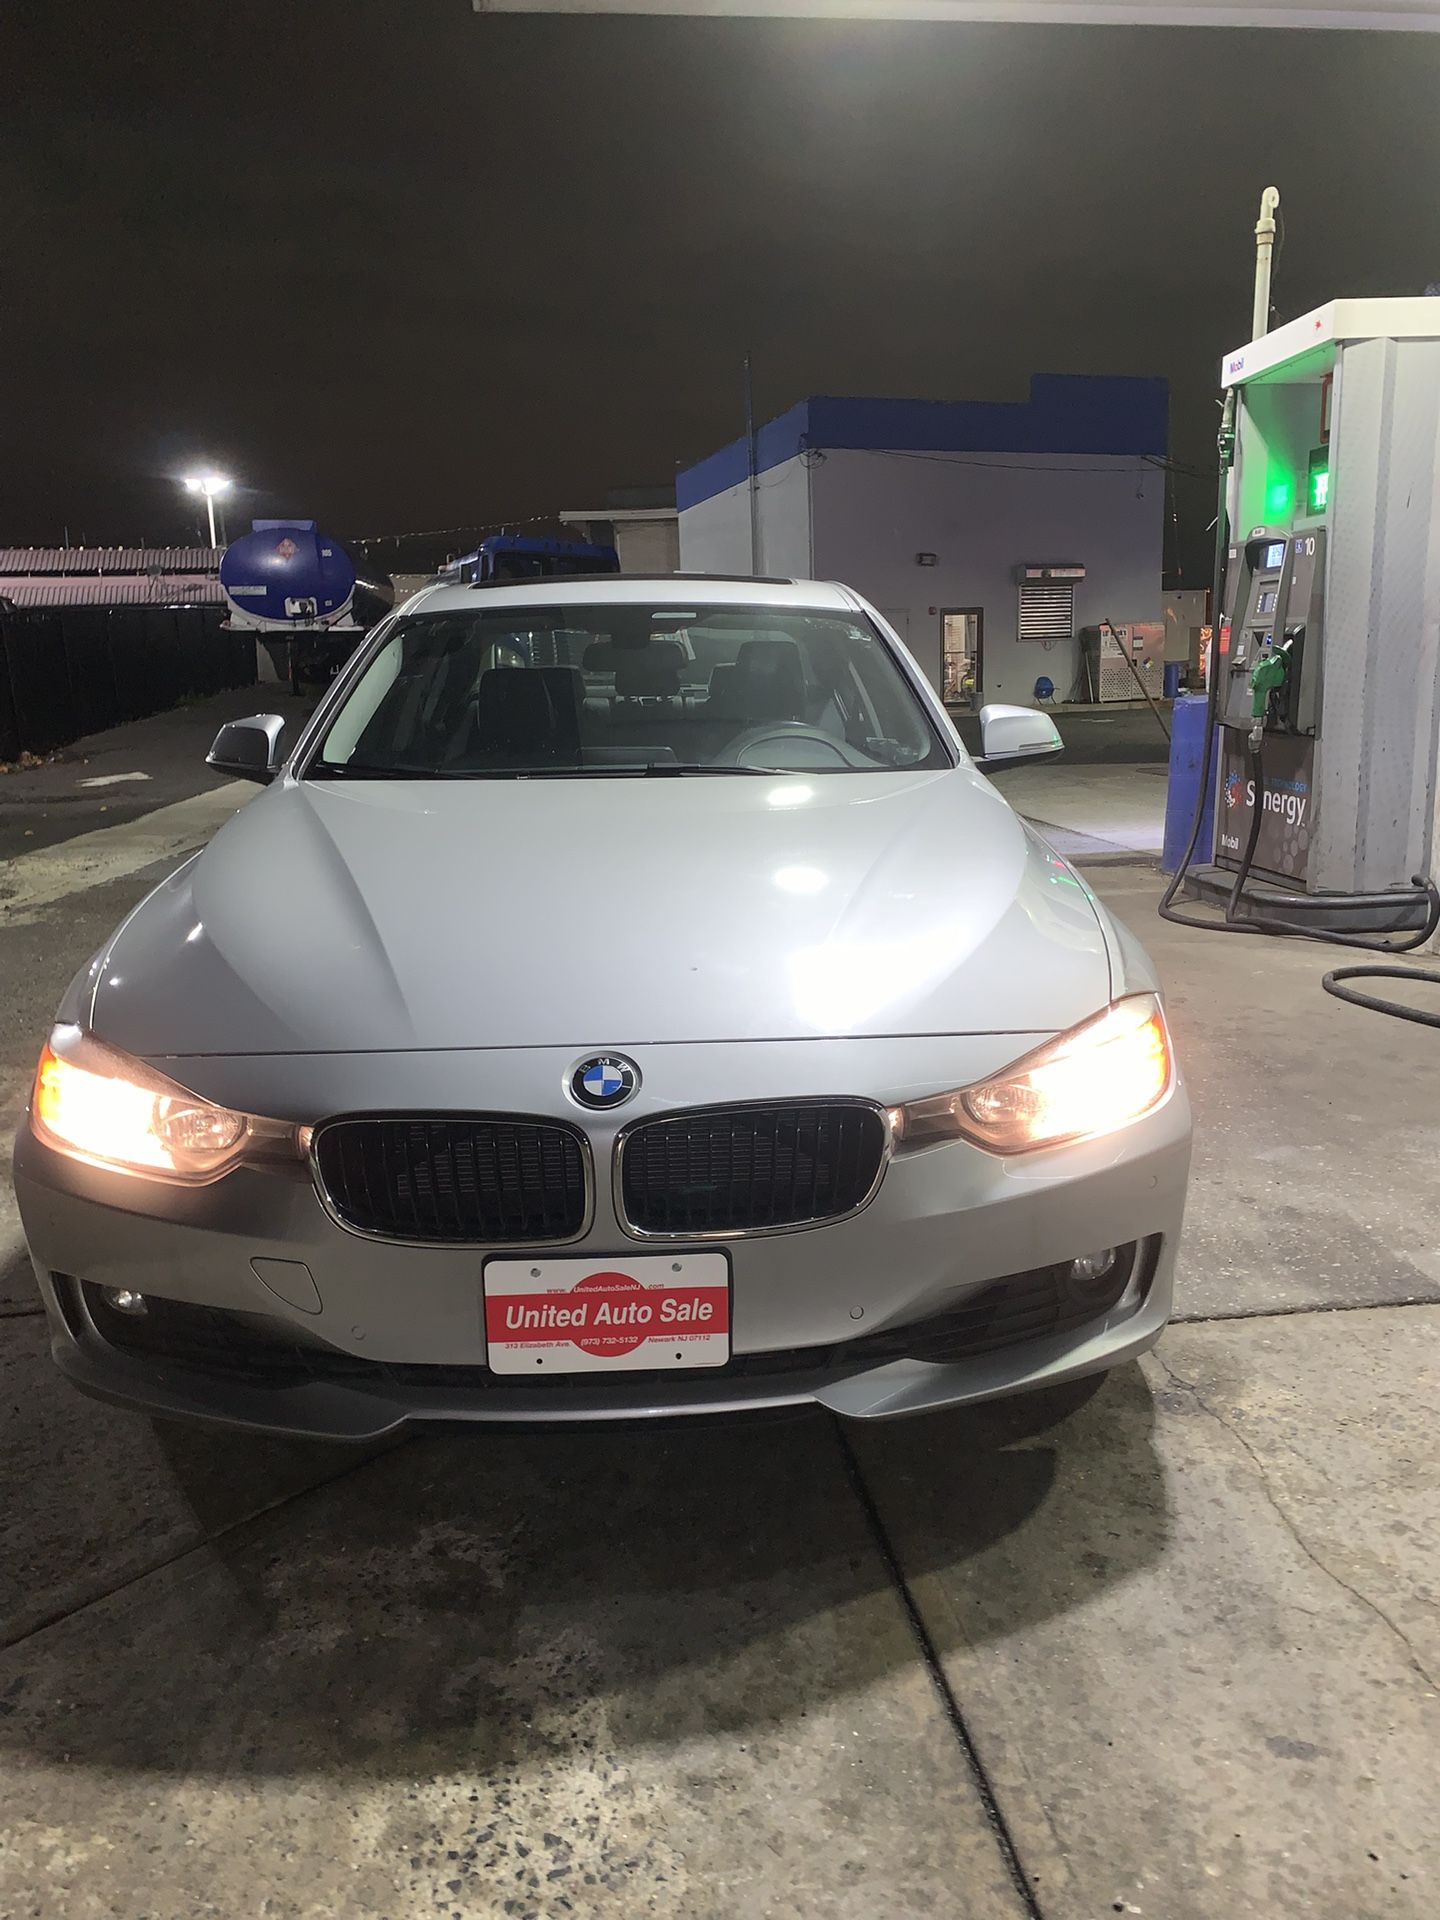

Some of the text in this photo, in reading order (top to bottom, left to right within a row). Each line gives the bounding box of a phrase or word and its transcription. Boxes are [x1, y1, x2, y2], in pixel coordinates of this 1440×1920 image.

[1229, 358, 1244, 372] Mobil
[1305, 537, 1315, 556] 10
[1246, 780, 1306, 826] Snergy
[1221, 834, 1239, 849] Mobil
[578, 1058, 630, 1072] BMW
[573, 1285, 641, 1293] UnitedAutoSaleNJ
[505, 1297, 713, 1329] United Auto Sale
[580, 1336, 639, 1347] (973) 732-5132
[648, 1336, 677, 1344] Newark
